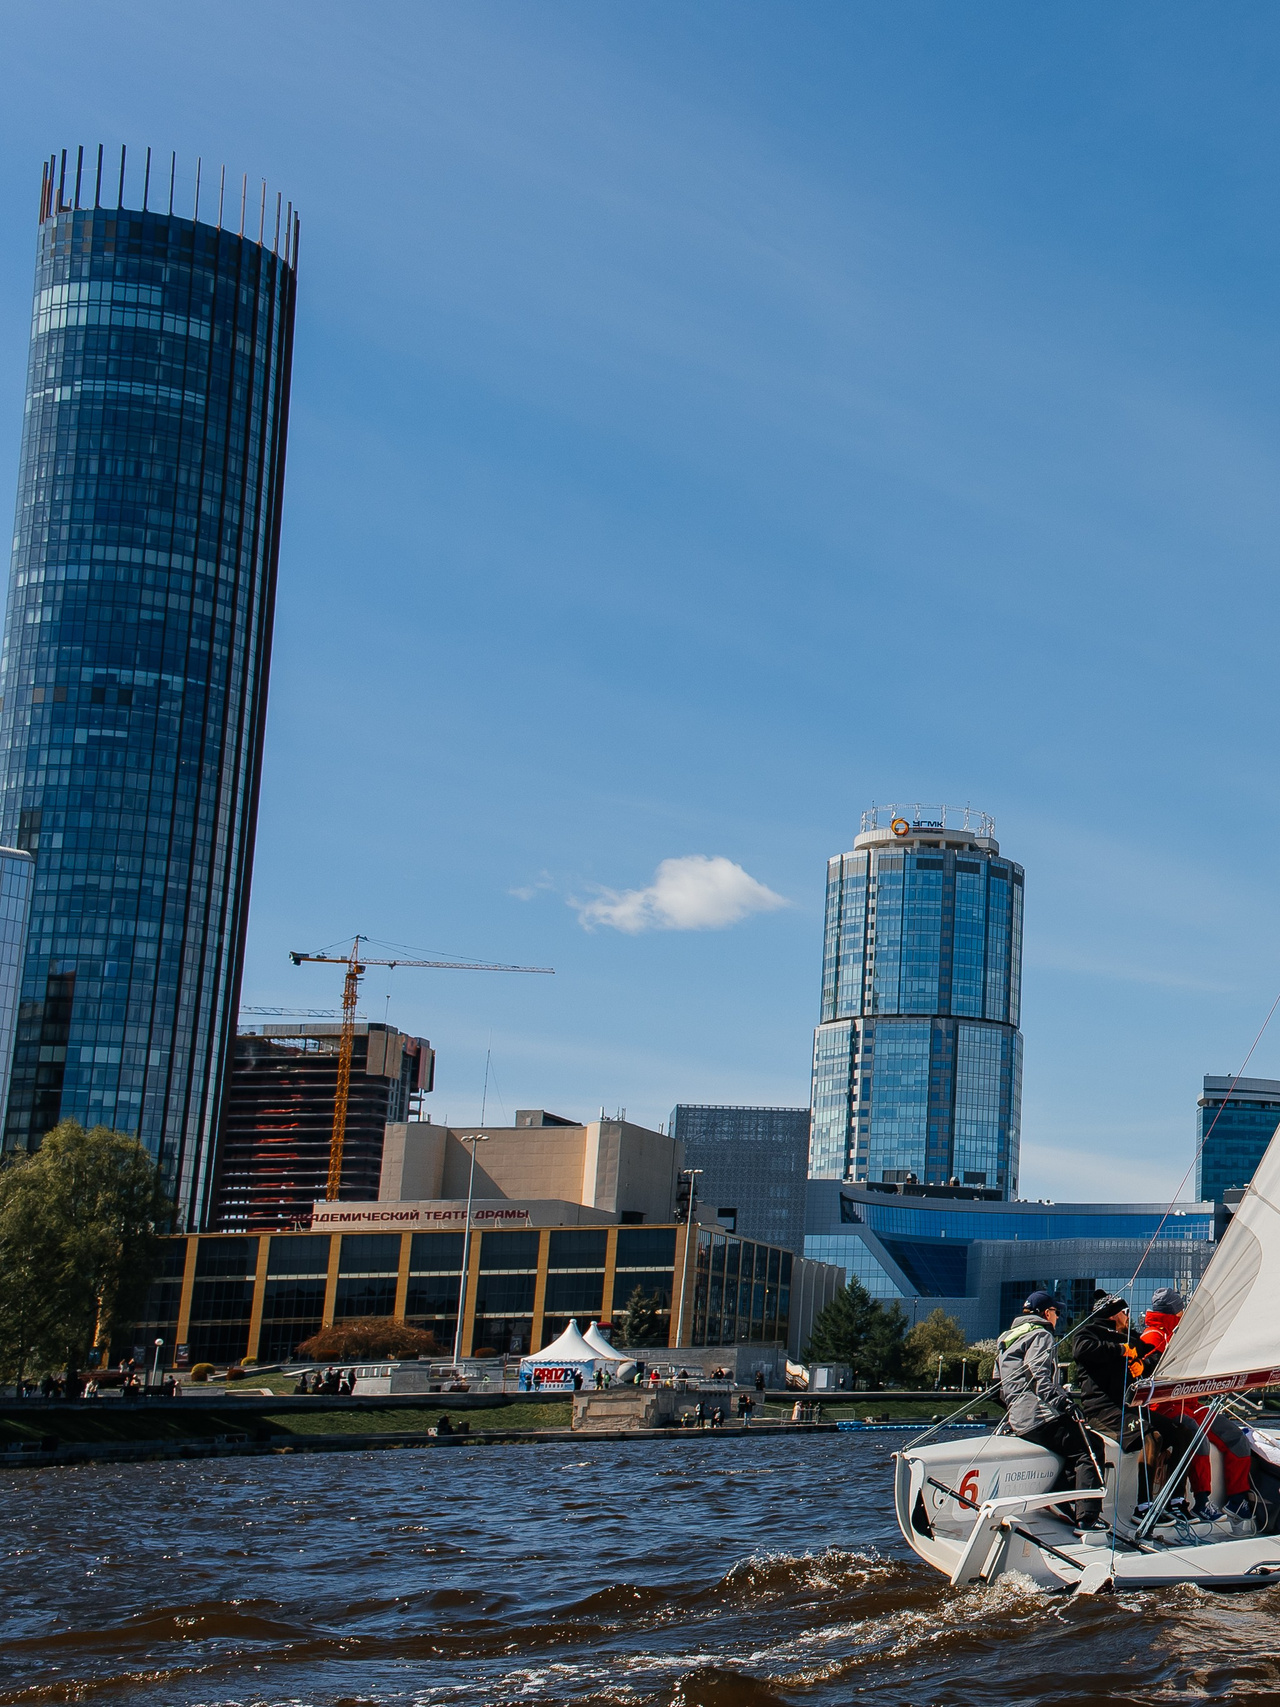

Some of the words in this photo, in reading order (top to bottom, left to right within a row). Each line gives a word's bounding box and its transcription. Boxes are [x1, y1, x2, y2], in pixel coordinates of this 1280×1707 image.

[912, 820, 944, 828] УГМК
[290, 1209, 420, 1223] АКАДЕМИЧЕСКИЙ
[424, 1210, 469, 1221] ТЕАТР
[474, 1209, 530, 1220] ДРАМЫ
[1171, 1376, 1238, 1399] @lordofthesail
[958, 1469, 980, 1510] 6
